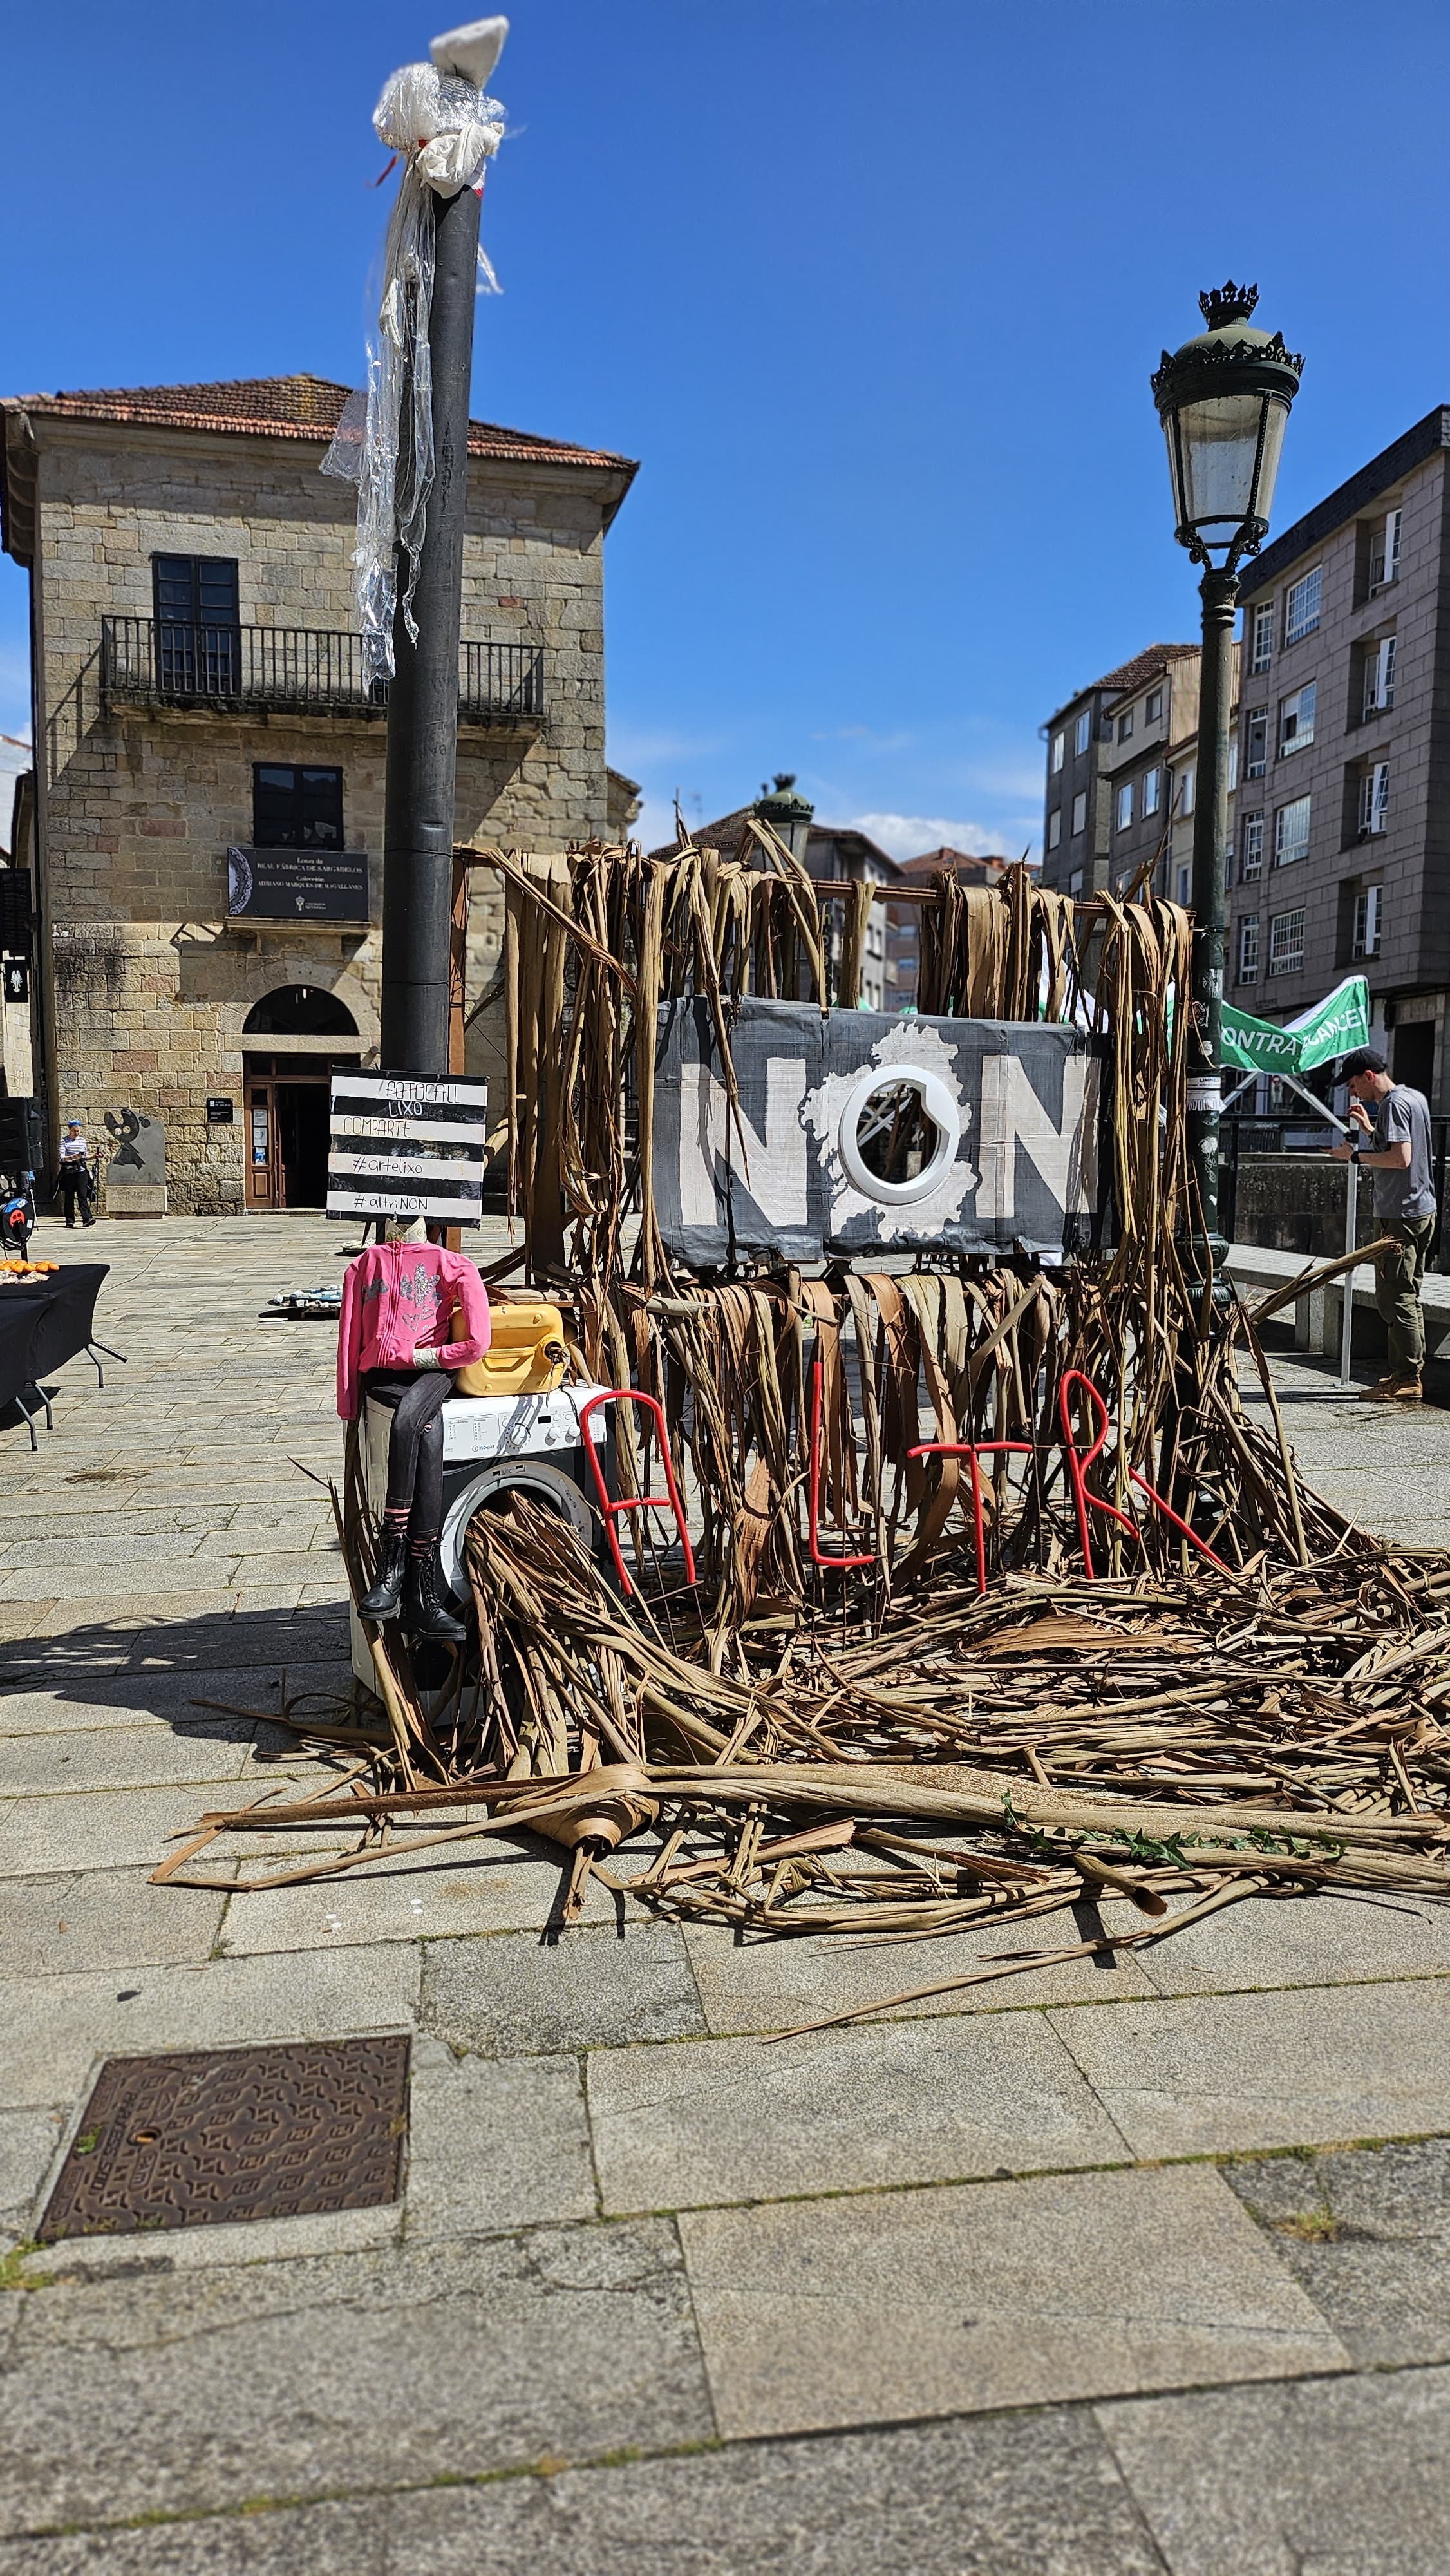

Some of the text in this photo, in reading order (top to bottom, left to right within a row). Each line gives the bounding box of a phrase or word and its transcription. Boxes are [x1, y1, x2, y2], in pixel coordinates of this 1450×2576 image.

[317, 865, 363, 874] SARGADELOS
[1221, 1027, 1297, 1056] ONTRA
[386, 1081, 460, 1104] FOTOCALL
[388, 1101, 422, 1117] LIXO
[344, 1117, 412, 1138] COMPARTE
[679, 1055, 1102, 1227] NON
[353, 1157, 423, 1174] #artelixo
[353, 1195, 428, 1211] #altriNON
